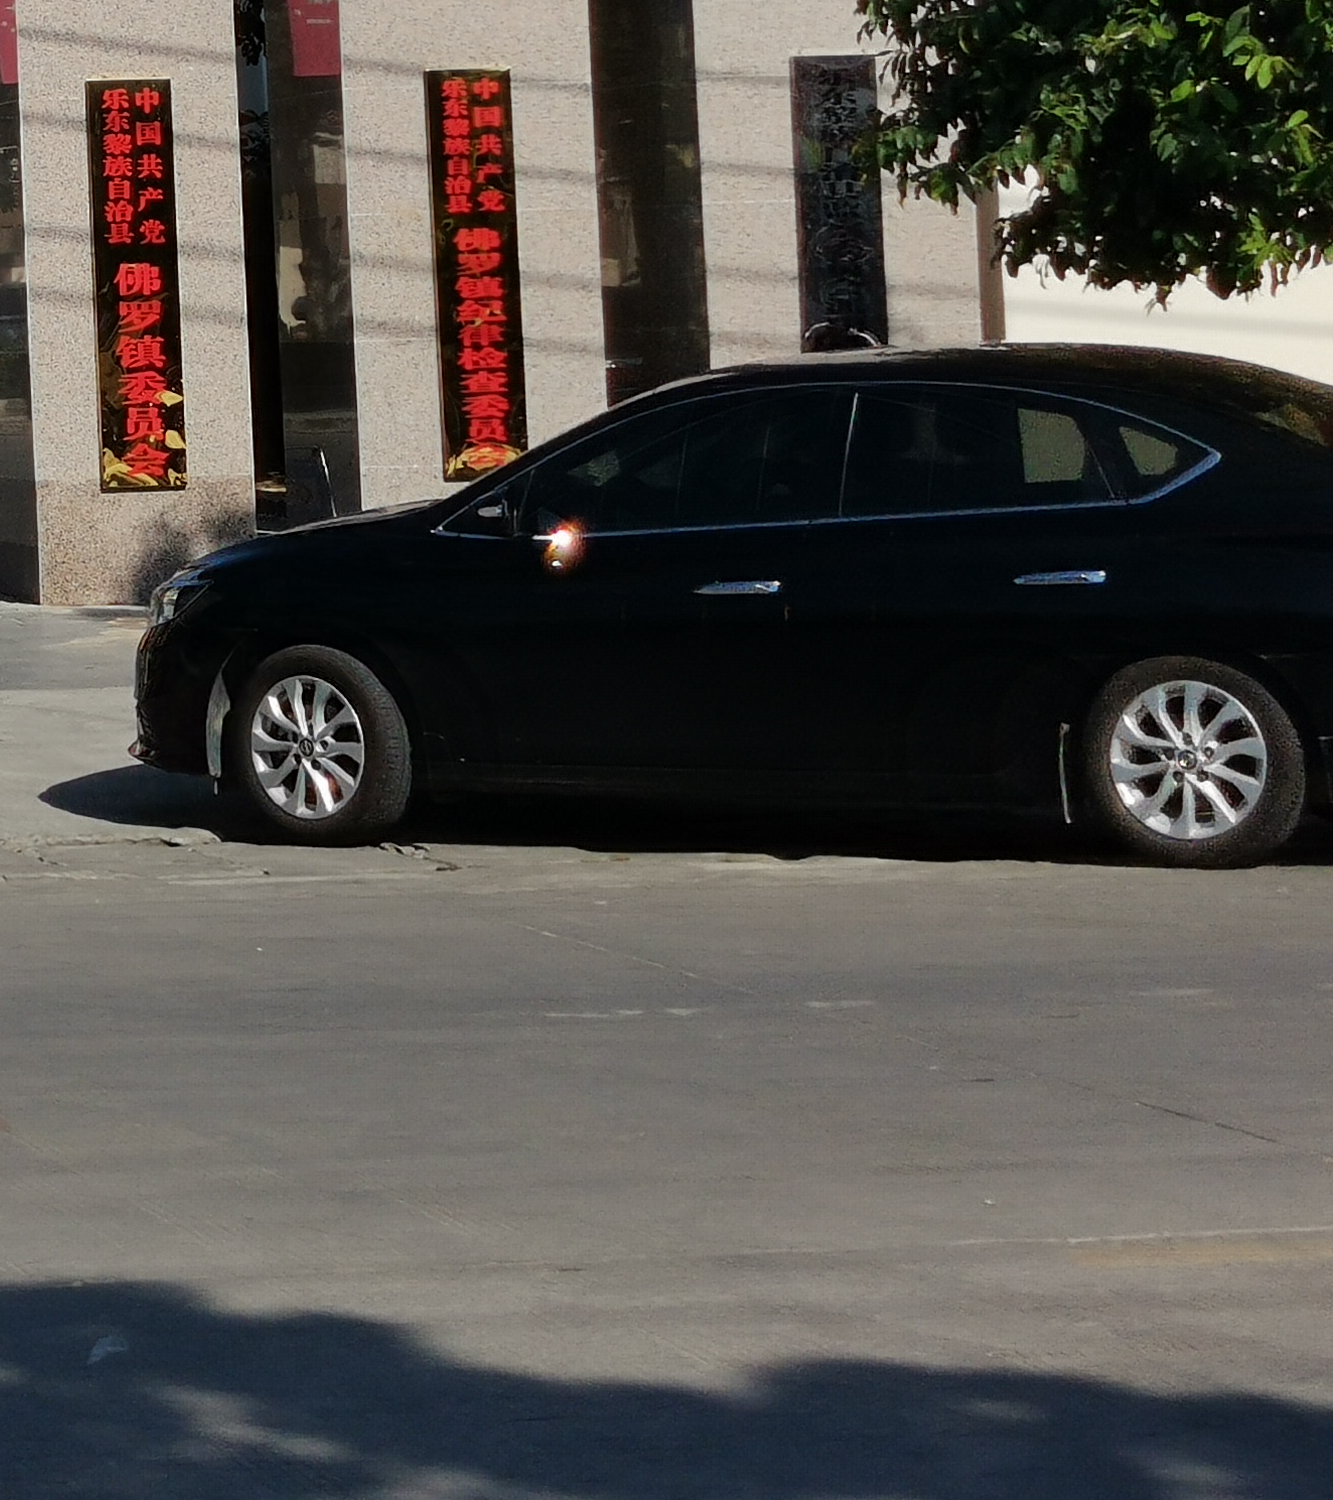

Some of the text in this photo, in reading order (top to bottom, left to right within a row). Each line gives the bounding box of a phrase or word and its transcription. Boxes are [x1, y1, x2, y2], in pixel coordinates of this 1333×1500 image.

[101, 88, 135, 245] 乐东黎族自治县
[134, 87, 166, 245] 中国共产党
[441, 79, 473, 214] 乐东黎族自治县
[473, 78, 506, 213] 中国共产党
[114, 262, 171, 477] 佛罗镇委员会
